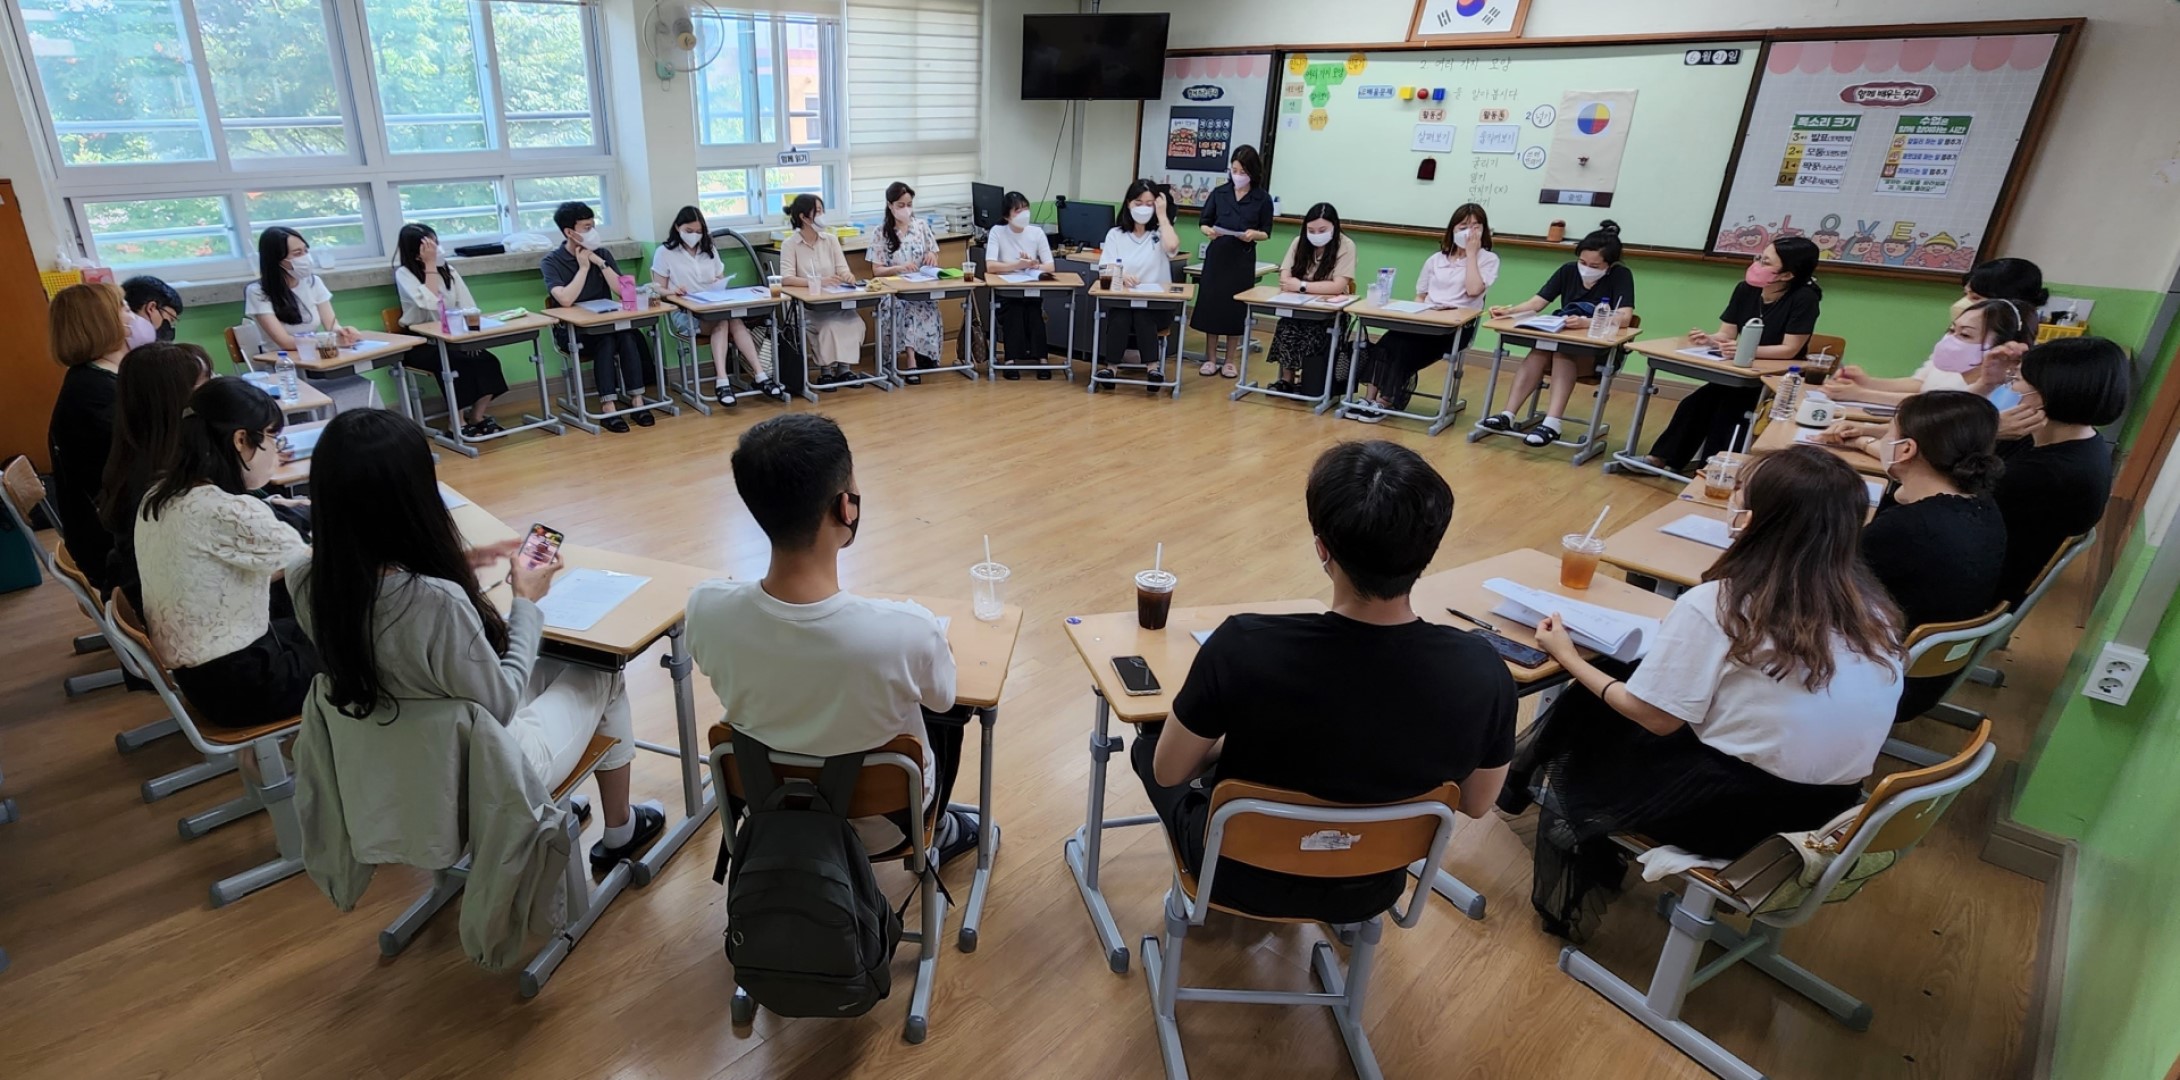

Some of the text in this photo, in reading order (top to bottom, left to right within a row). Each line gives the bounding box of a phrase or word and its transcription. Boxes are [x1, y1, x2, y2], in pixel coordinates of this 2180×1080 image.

[1436, 57, 1454, 71] 여러
[1461, 57, 1479, 70] 가지
[1488, 56, 1511, 72] 모양
[1857, 89, 1920, 99] 함께 배우는 우리
[1525, 111, 1532, 120] 2
[1797, 116, 1856, 127] 목소리 크기
[1919, 116, 1949, 126] 수업은
[1949, 126, 1966, 134] 시간
[1417, 130, 1450, 144] 살펴보기
[1793, 132, 1801, 142] 3
[1787, 147, 1796, 155] 2
[1779, 175, 1787, 183] 0
